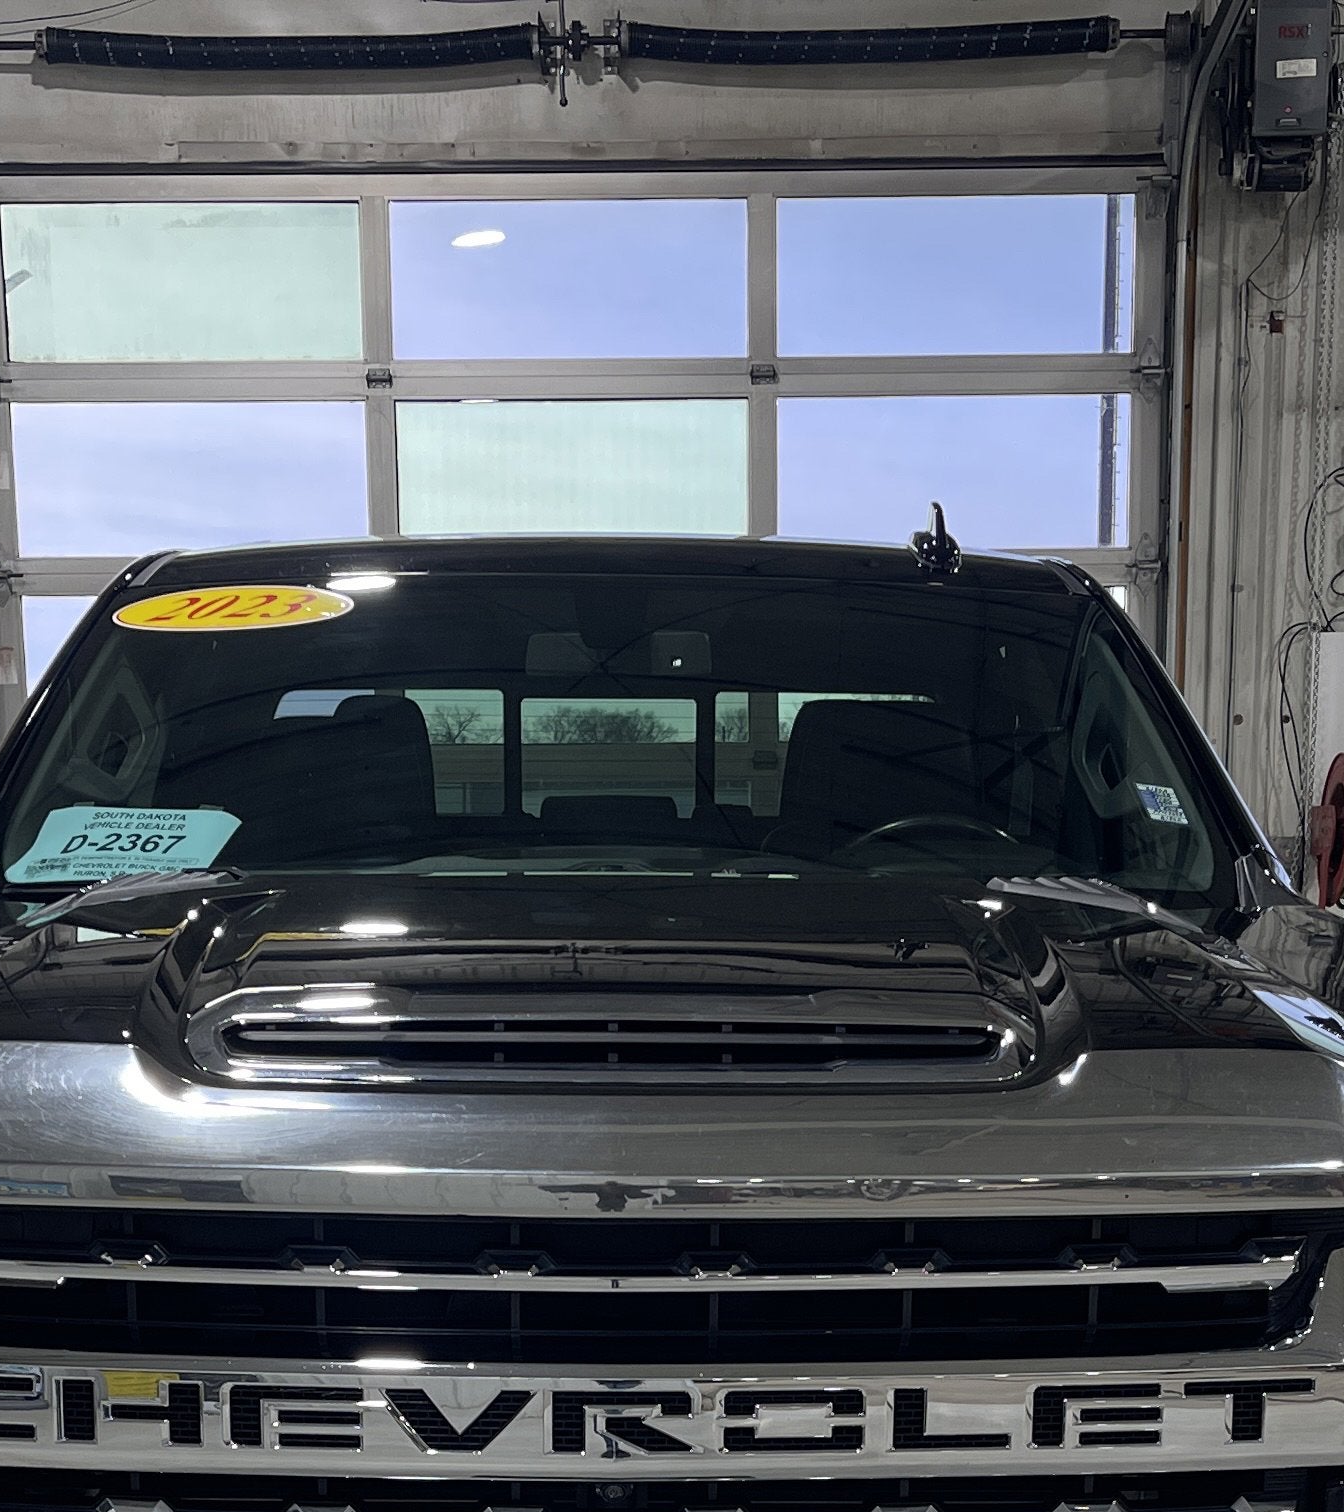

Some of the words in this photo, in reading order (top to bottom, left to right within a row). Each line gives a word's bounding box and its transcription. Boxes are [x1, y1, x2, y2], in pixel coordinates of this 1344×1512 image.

[144, 594, 318, 622] 2023
[92, 811, 135, 820] SOUTH
[136, 812, 187, 821] DAKOTA
[84, 821, 134, 831] VEHICLE
[135, 822, 186, 831] DEALER
[60, 832, 187, 855] D-2367
